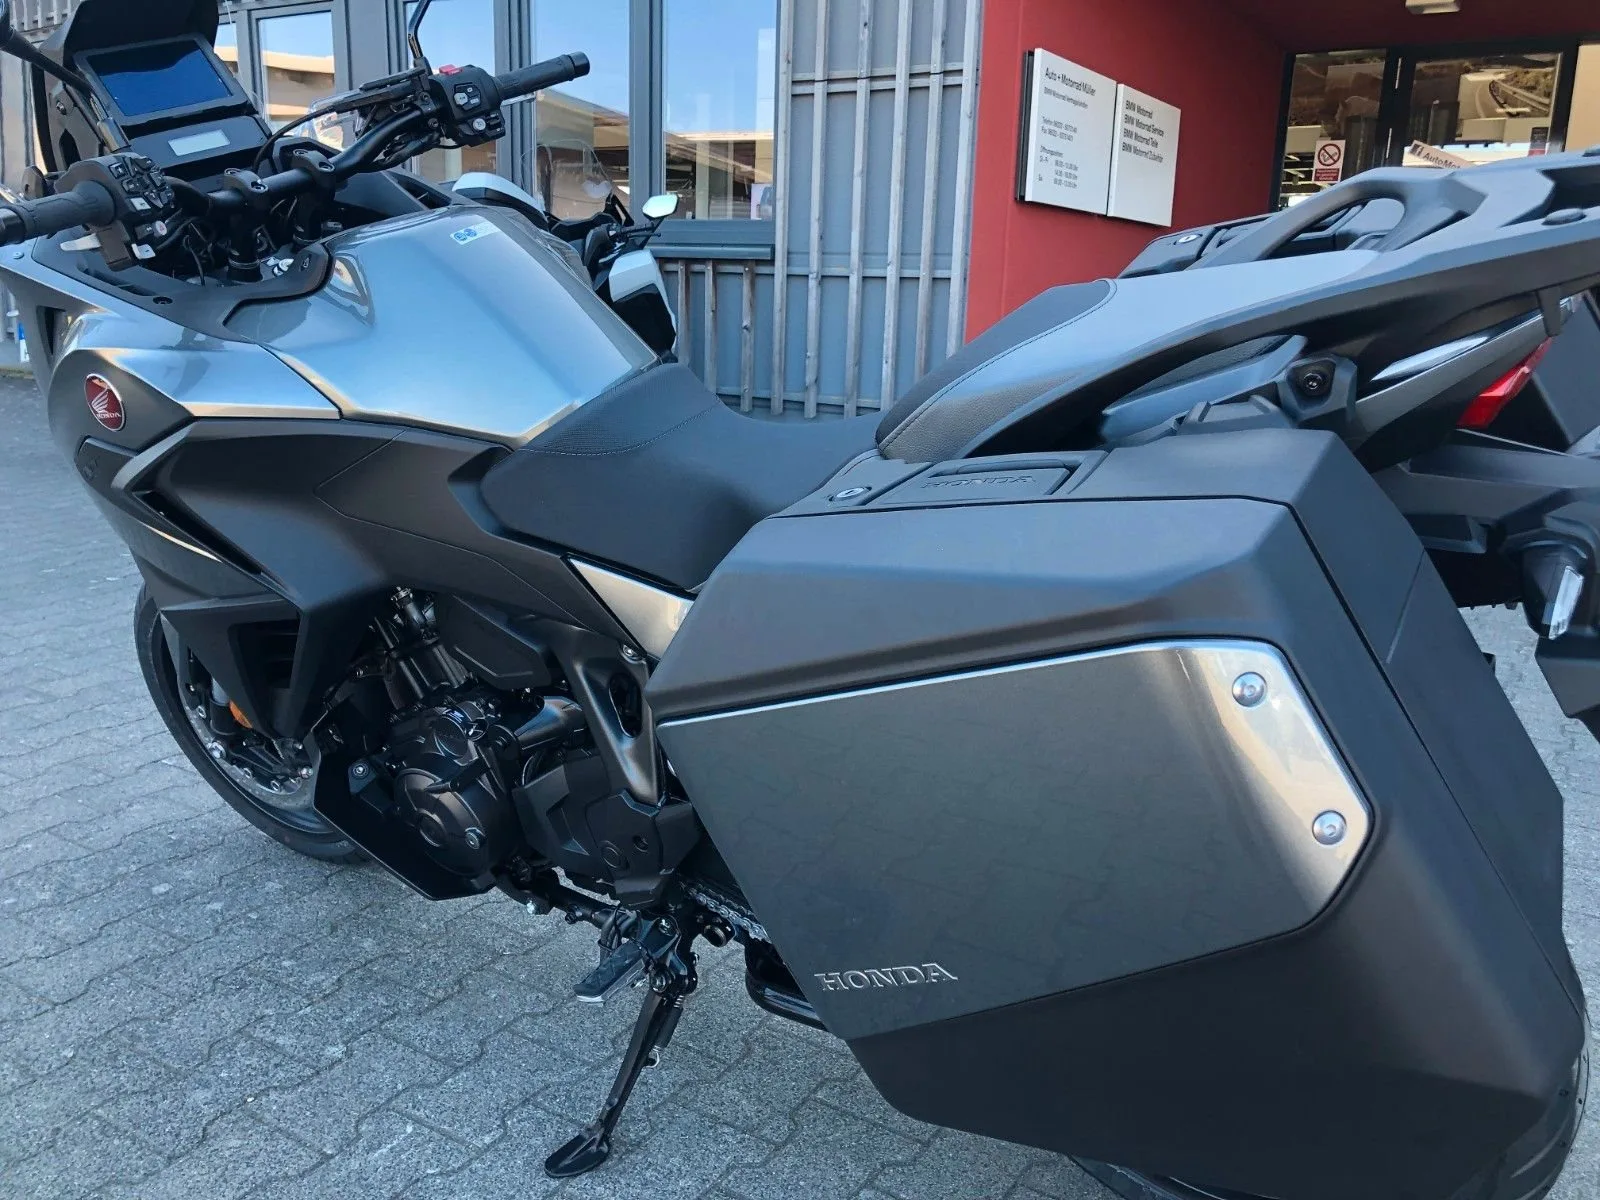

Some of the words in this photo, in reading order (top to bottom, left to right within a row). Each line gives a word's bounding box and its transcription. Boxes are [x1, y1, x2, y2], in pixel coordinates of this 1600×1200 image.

[1045, 67, 1057, 81] Auto
[1061, 73, 1082, 91] Motorrad
[1125, 100, 1136, 112] BMW
[1136, 104, 1153, 119] Motorrad
[1125, 114, 1134, 126] BMW
[1135, 118, 1151, 132] Motorrad
[1123, 128, 1133, 139] BMW
[1134, 132, 1150, 145] Motorrad
[1122, 142, 1132, 153] BMW
[920, 475, 1036, 488] HONDA
[813, 962, 959, 991] HONDA
